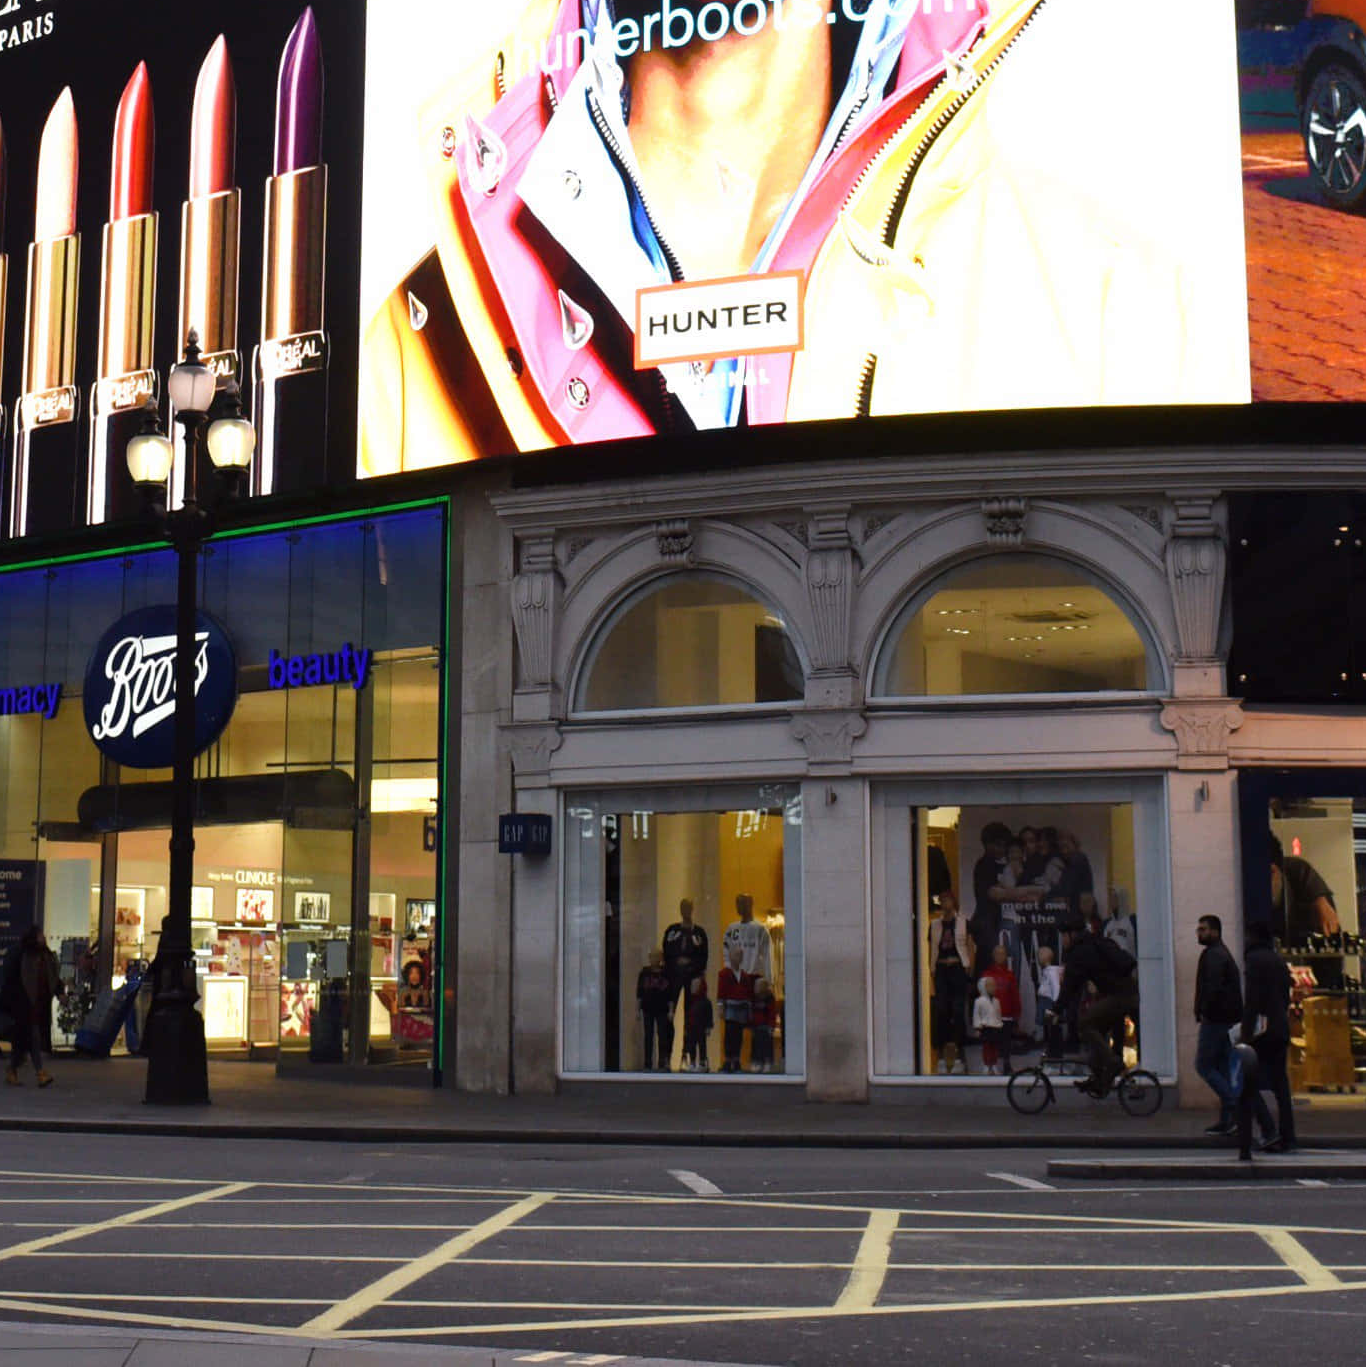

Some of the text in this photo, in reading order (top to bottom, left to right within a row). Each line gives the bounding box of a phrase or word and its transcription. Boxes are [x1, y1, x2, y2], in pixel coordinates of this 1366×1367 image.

[649, 301, 787, 337] HUNTER
[268, 641, 372, 690] beauty
[93, 631, 209, 740] Boos
[504, 824, 524, 842] GAP
[235, 870, 276, 886] CLINIQUE
[1001, 901, 1042, 911] meet
[1031, 913, 1056, 924] the
